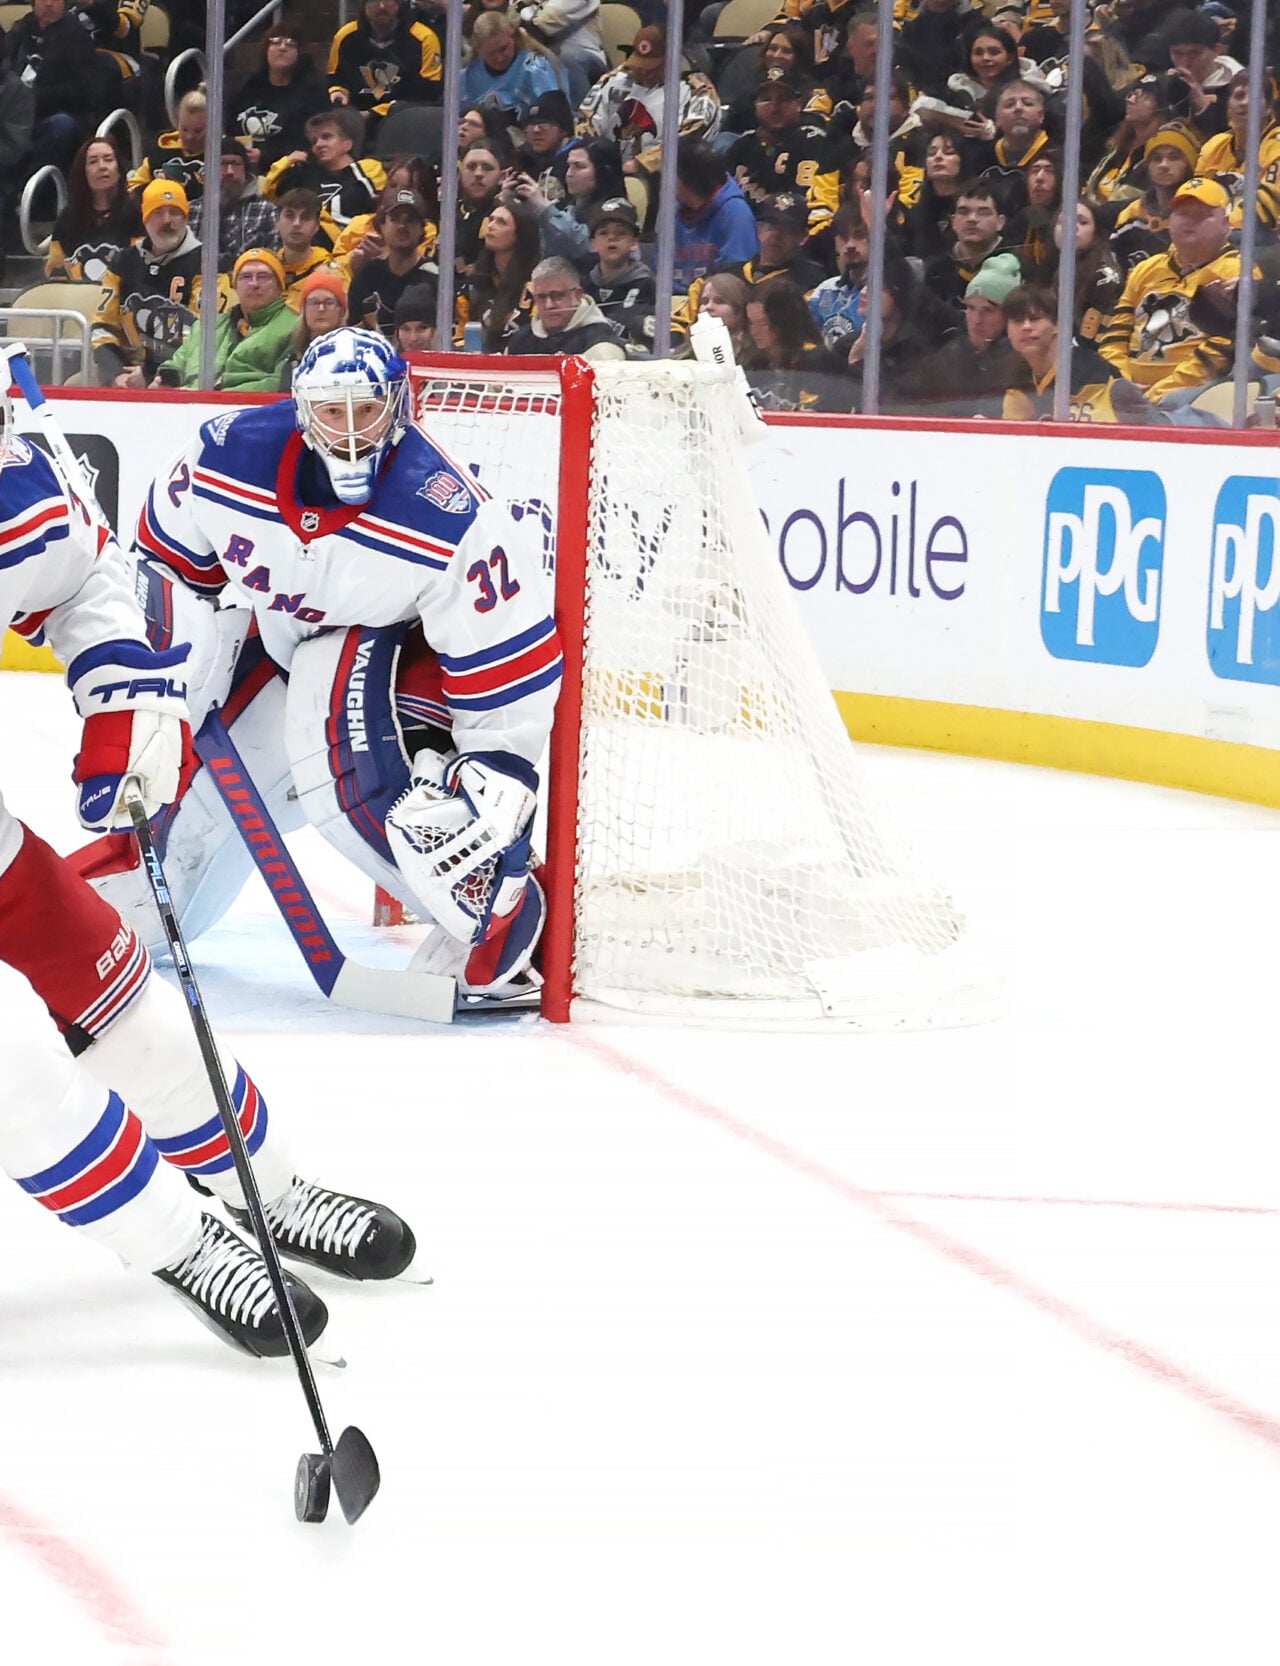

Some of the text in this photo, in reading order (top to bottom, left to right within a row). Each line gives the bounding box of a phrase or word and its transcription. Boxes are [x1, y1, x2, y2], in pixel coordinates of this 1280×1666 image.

[97, 288, 114, 312] 7
[466, 545, 520, 613] 32
[758, 478, 969, 601] obile
[1045, 485, 1162, 646] PPG
[1210, 494, 1280, 664] PP
[87, 677, 187, 704] TRU
[345, 638, 376, 752] VAUGHN
[80, 785, 111, 812] TRUE
[145, 846, 170, 905] TRUE
[208, 757, 332, 964] WARRIOR
